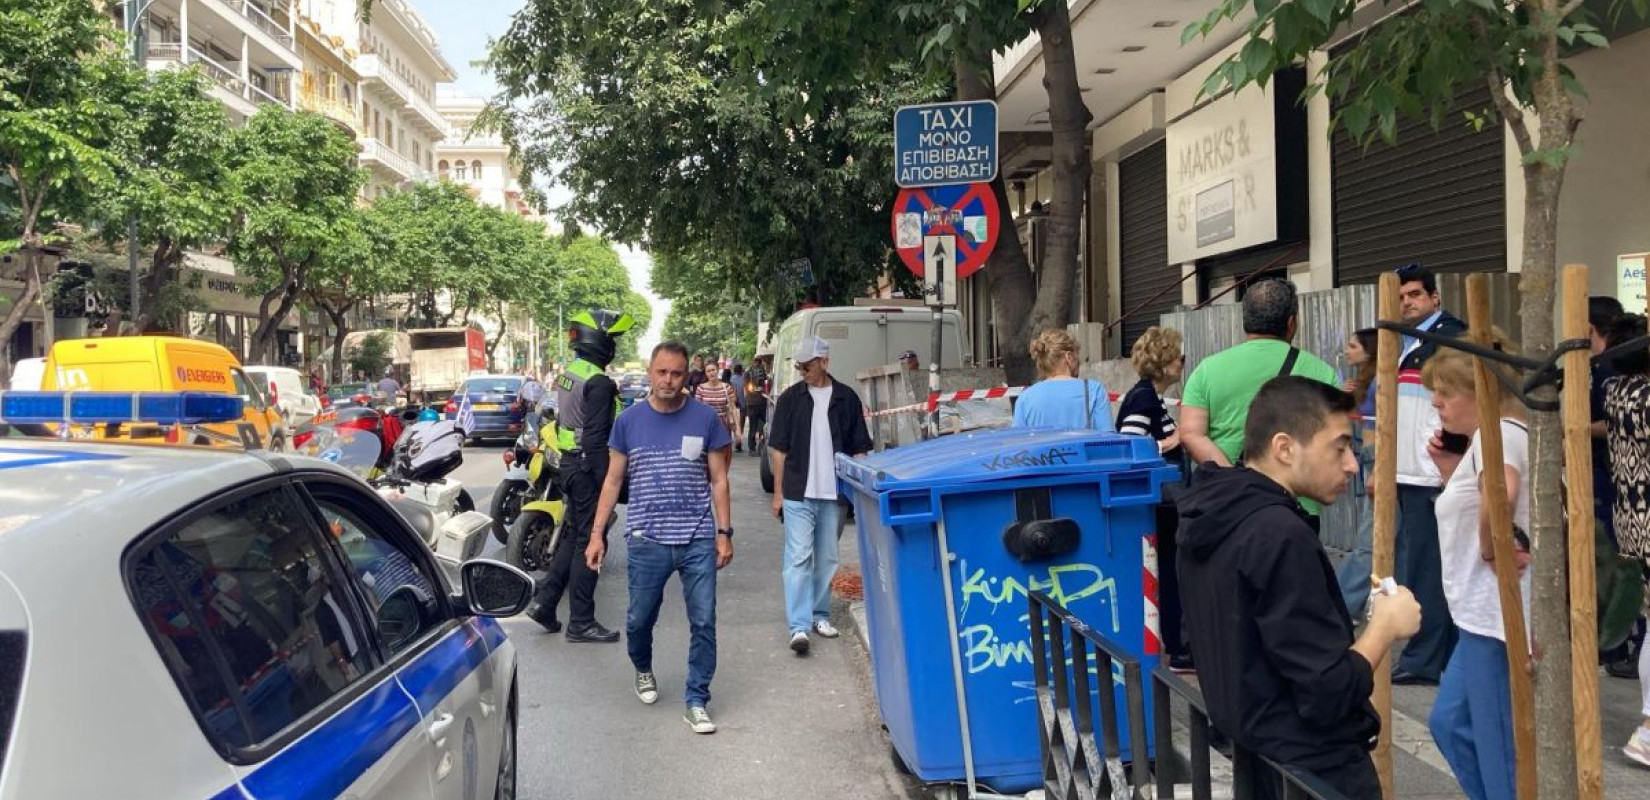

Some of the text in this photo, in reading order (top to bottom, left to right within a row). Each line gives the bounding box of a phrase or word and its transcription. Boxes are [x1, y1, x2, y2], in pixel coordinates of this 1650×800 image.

[919, 107, 972, 131] TAXI
[919, 131, 972, 148] ΜΟΝΟ
[902, 146, 990, 165] ΕΠΙΒΙΒΑΣΗ
[1179, 125, 1235, 182] MARKS
[900, 163, 991, 182] ΑΠΟΒΙΒΑΣΗ
